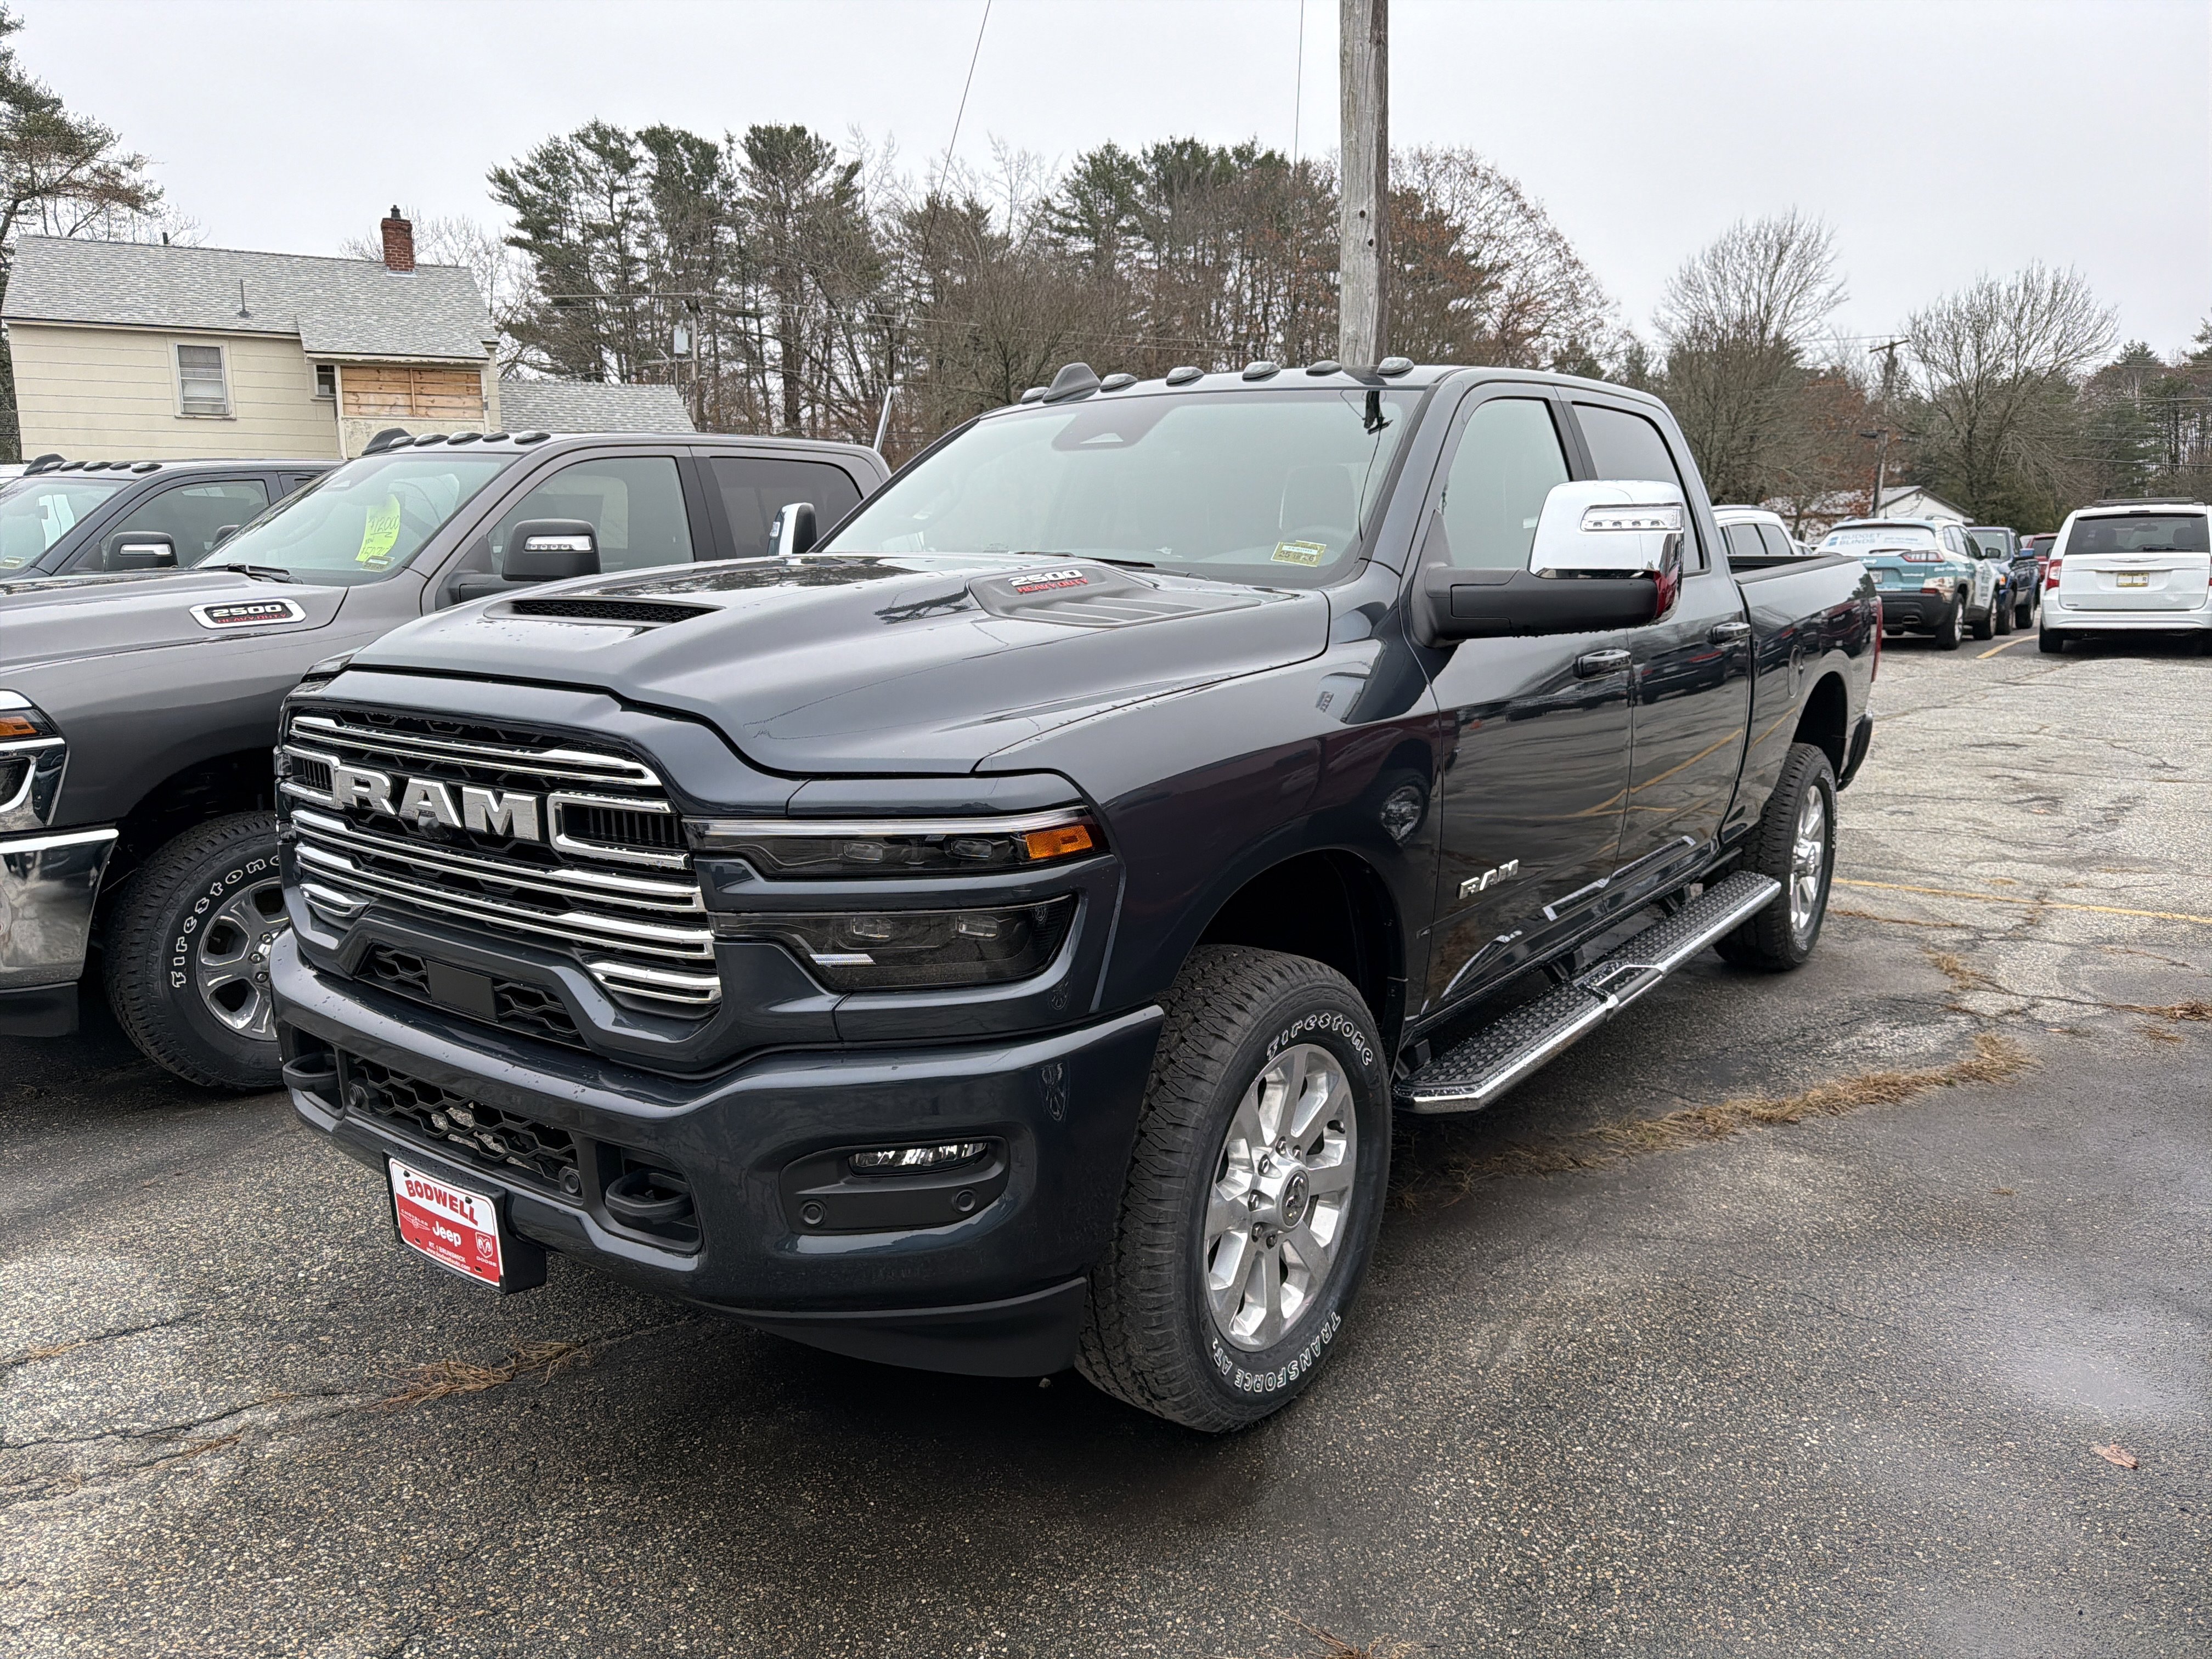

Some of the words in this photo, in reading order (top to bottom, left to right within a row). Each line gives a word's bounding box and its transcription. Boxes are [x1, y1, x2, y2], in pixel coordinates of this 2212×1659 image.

[1008, 569, 1083, 586] 2500
[1017, 582, 1056, 594] HEAVY
[1057, 578, 1089, 589] DUTY
[211, 604, 283, 618] 2500
[217, 615, 256, 623] HEAVY
[336, 764, 540, 842] RAM
[1458, 859, 1519, 900] RAM
[1266, 1013, 1373, 1066] Firestone
[405, 1180, 478, 1227] BODWELL
[400, 1209, 428, 1227] CHRYSLER
[432, 1220, 461, 1247] Jeep
[476, 1256, 497, 1267] DODGE
[1234, 1311, 1341, 1392] TRANSFORCE
